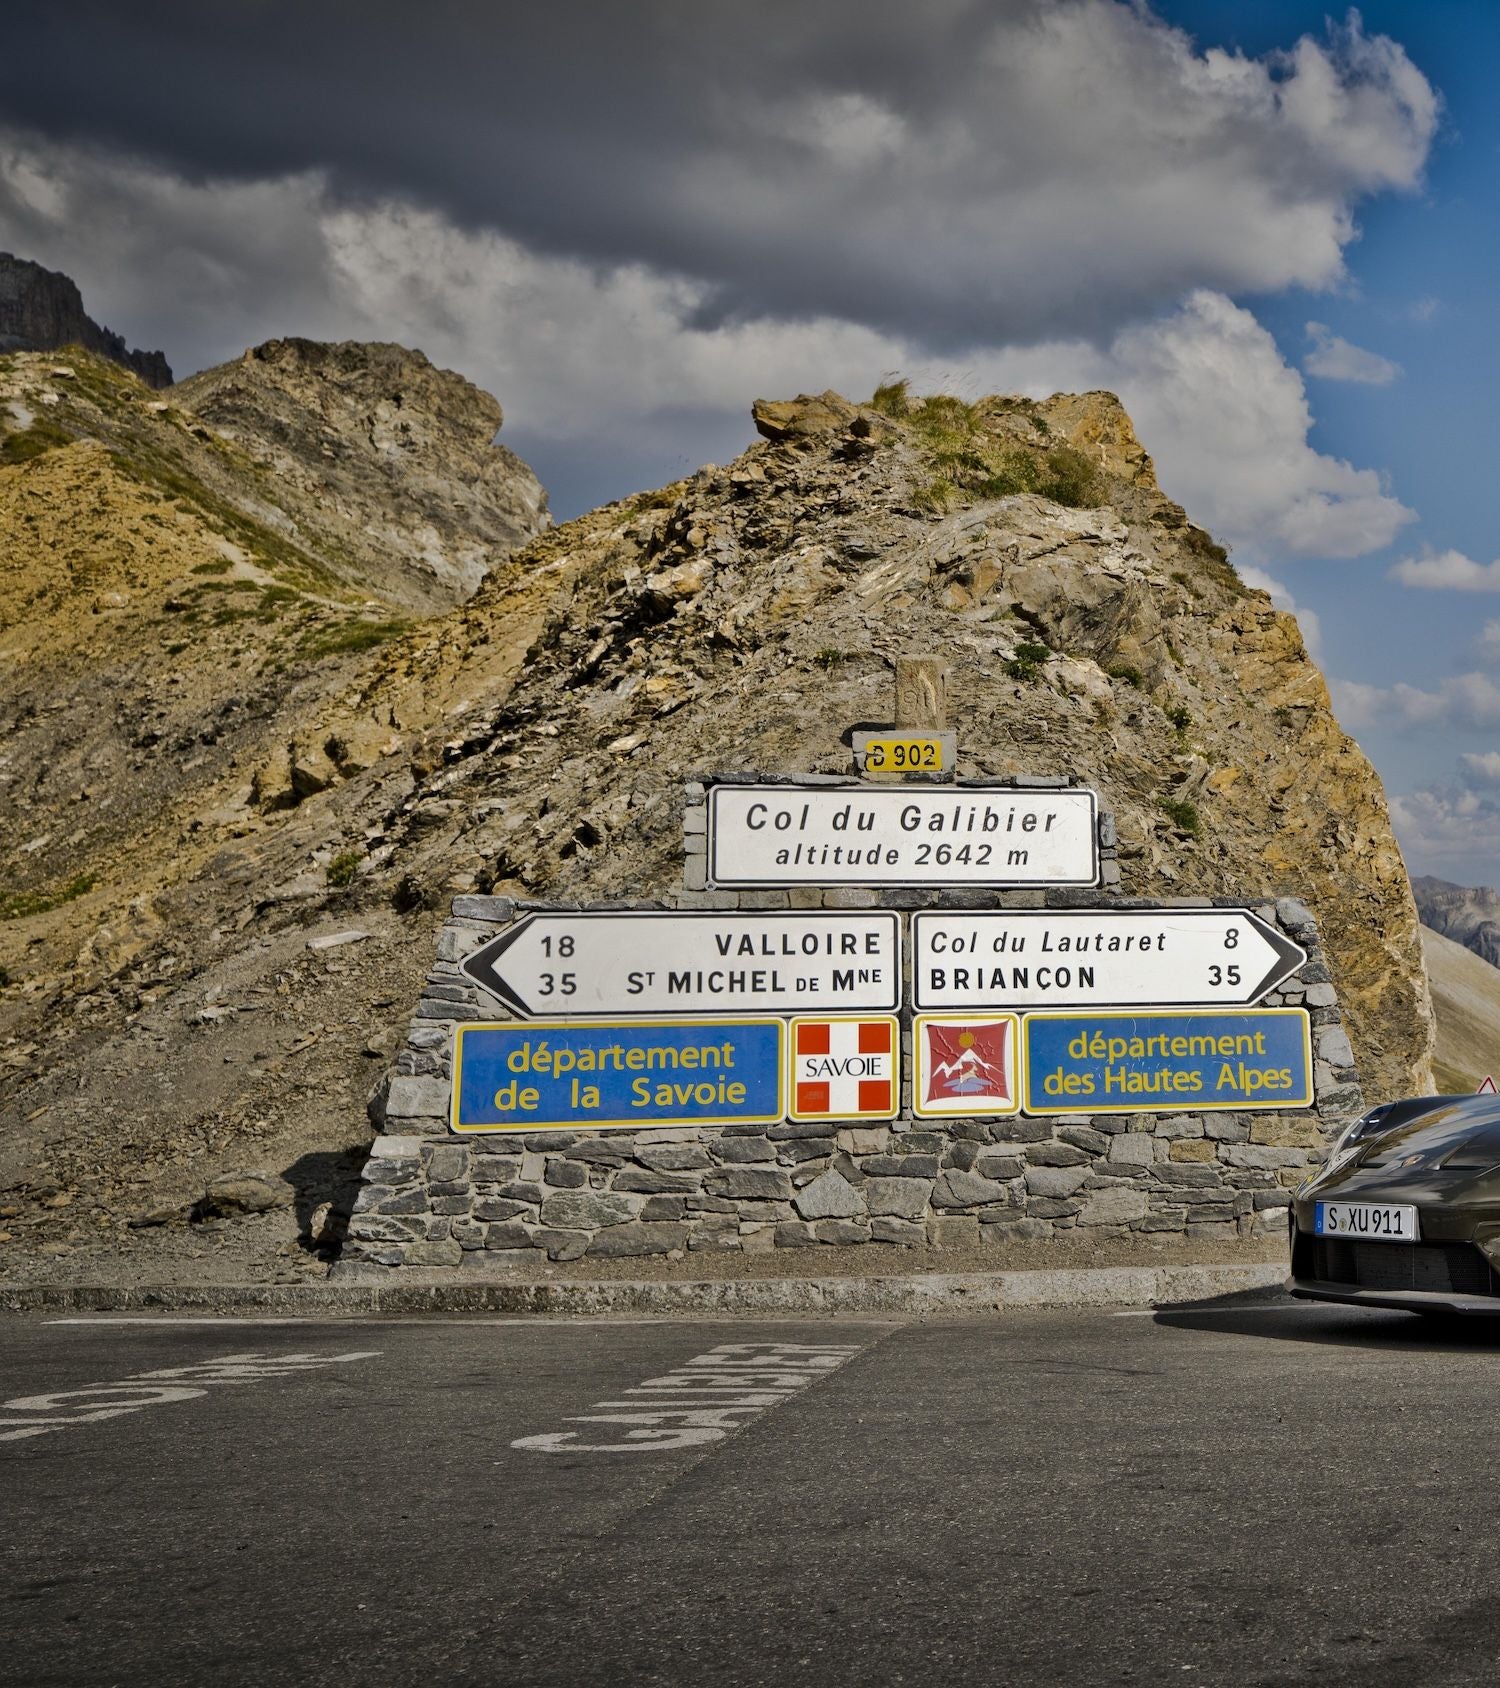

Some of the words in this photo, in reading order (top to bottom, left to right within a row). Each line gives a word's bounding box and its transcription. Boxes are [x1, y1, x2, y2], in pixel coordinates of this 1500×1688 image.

[873, 745, 885, 766] D
[894, 744, 936, 766] 902
[746, 804, 809, 831] Col
[832, 804, 875, 831] du
[900, 805, 1057, 832] Galibier
[775, 843, 899, 865] altitude
[914, 843, 992, 866] 2642
[1007, 850, 1028, 865] m
[541, 935, 575, 958] 18
[714, 933, 881, 956] VALLOIRE
[930, 931, 977, 954] Col
[993, 931, 1026, 953] du
[1041, 931, 1167, 953] Lautaret
[1223, 928, 1239, 950] 8
[538, 973, 577, 996] 35
[668, 970, 786, 994] MICHEL
[931, 966, 1095, 991] BRIANÇON
[1208, 965, 1241, 987] 35
[507, 1041, 735, 1077] département
[1068, 1029, 1266, 1064] département
[805, 1056, 882, 1078] SAVOIE
[1044, 1071, 1096, 1095] des
[1105, 1069, 1203, 1094] Hautes
[1217, 1062, 1293, 1096] Alpes
[494, 1080, 539, 1111] de
[571, 1079, 600, 1108] la
[631, 1075, 747, 1107] Savoie
[1328, 1207, 1337, 1230] S
[1348, 1208, 1368, 1232] XU
[1372, 1209, 1403, 1235] 911
[0, 1351, 385, 1441] LOIRE
[508, 1342, 864, 1453] GALIBIER
